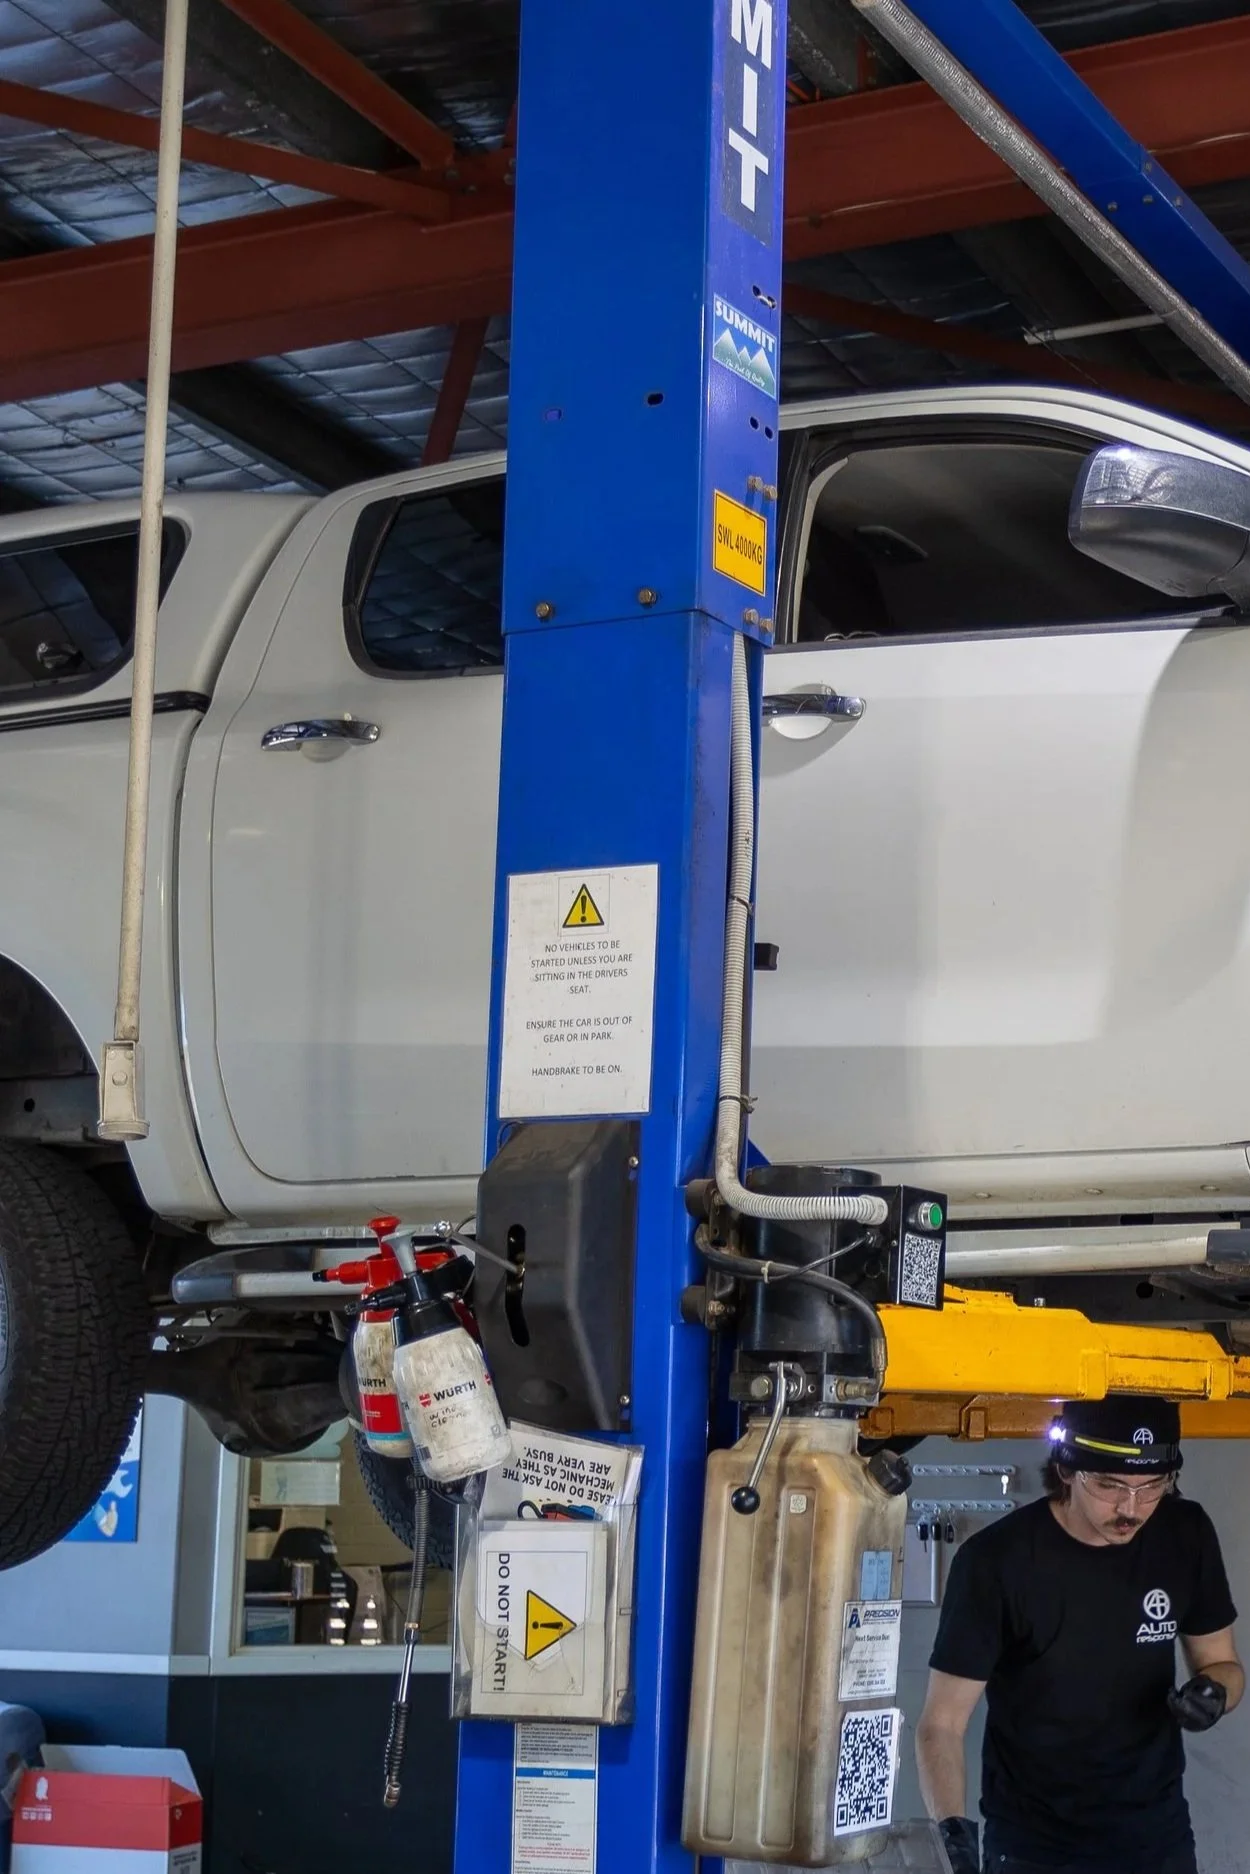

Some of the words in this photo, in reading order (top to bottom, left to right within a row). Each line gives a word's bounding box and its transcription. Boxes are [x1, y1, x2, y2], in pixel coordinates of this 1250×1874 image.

[715, 300, 775, 353] SUMMIT
[717, 524, 734, 551] SWL
[735, 534, 763, 565] 4000KG
[545, 943, 557, 953] NO
[559, 941, 595, 952] VEHICLES
[598, 940, 608, 949] TO
[610, 940, 620, 949] BE
[531, 959, 566, 968] STARTED
[567, 956, 597, 966] UNLESS
[599, 955, 616, 964] YOU
[617, 953, 633, 962] ARE
[535, 972, 565, 982] SITTING
[567, 972, 576, 980] IN
[578, 970, 593, 979] THE
[595, 968, 628, 978] DRIVERS
[569, 985, 591, 994] SEAT.
[526, 1020, 557, 1030] ENSURE
[559, 1019, 574, 1028] THE
[576, 1018, 592, 1027] CAR
[594, 1018, 601, 1026] IS
[602, 1016, 620, 1026] OUT
[622, 1016, 633, 1025] OF
[543, 1034, 565, 1043] GEAR
[567, 1033, 578, 1042] OR
[580, 1032, 589, 1041] IN
[591, 1032, 614, 1041] PARK.
[532, 1066, 580, 1076] HANDBRAKE
[583, 1065, 594, 1075] TO
[596, 1065, 605, 1074] BE
[608, 1064, 622, 1073] ON.
[524, 1446, 554, 1462] BUSY.
[516, 1458, 541, 1473] THEY
[543, 1464, 557, 1476] AS
[557, 1456, 585, 1471] VERY
[589, 1461, 612, 1476] ARE
[502, 1468, 520, 1481] THE
[522, 1473, 543, 1487] ASK
[559, 1469, 615, 1491] MECHANIC
[545, 1480, 566, 1494] NOT
[569, 1485, 584, 1498] DO
[498, 1553, 510, 1579] DO
[497, 1585, 510, 1622] NOT
[1136, 1620, 1177, 1636] AUTO
[493, 1627, 509, 1692] START!
